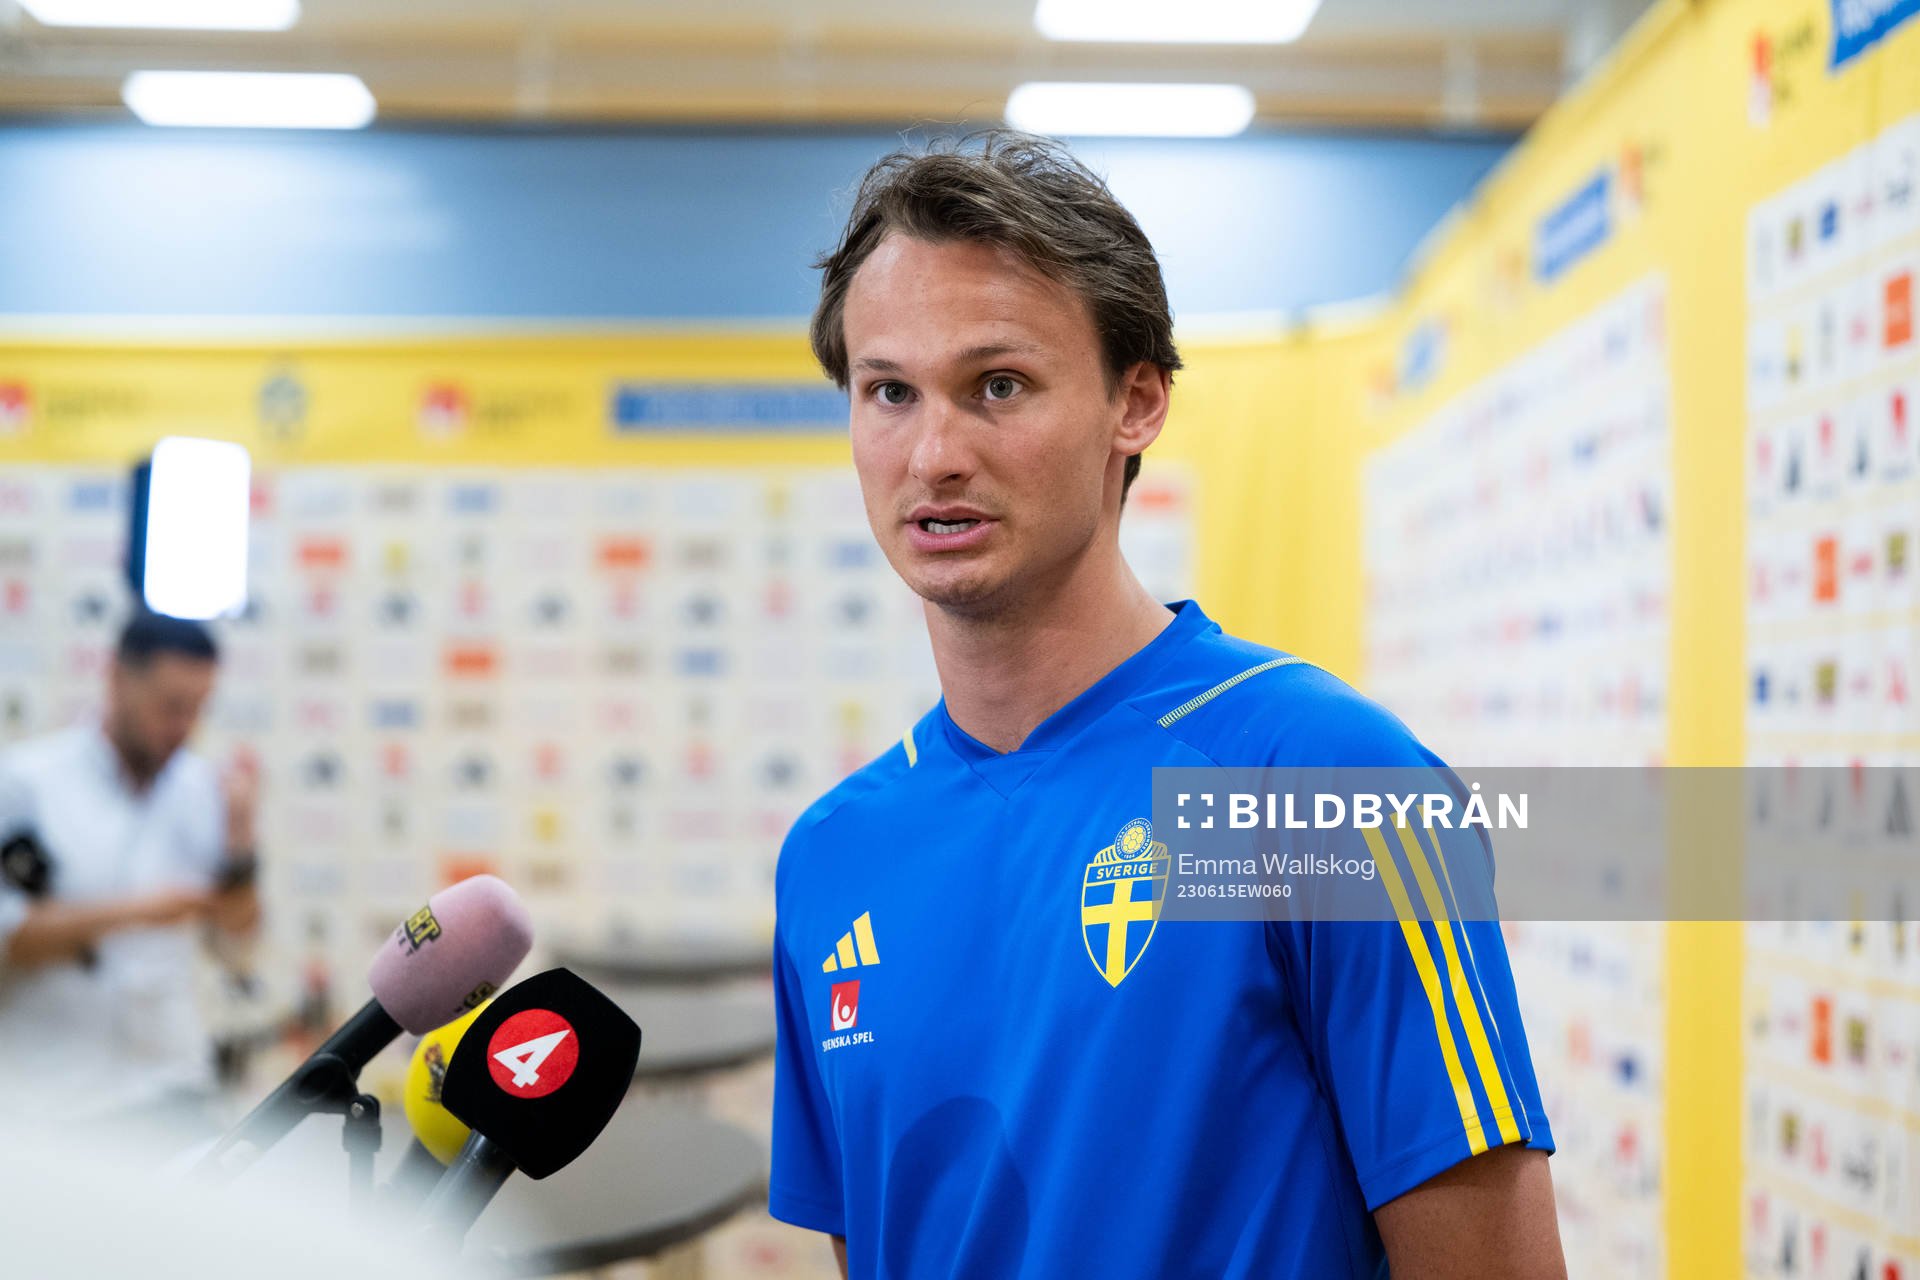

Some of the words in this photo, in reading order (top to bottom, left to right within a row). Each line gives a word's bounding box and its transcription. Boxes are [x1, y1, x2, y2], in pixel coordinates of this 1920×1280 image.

[1096, 862, 1159, 880] SVERIGE
[822, 1035, 851, 1052] SVENSKA
[852, 1031, 875, 1046] SPEL
[492, 1029, 571, 1089] 4
